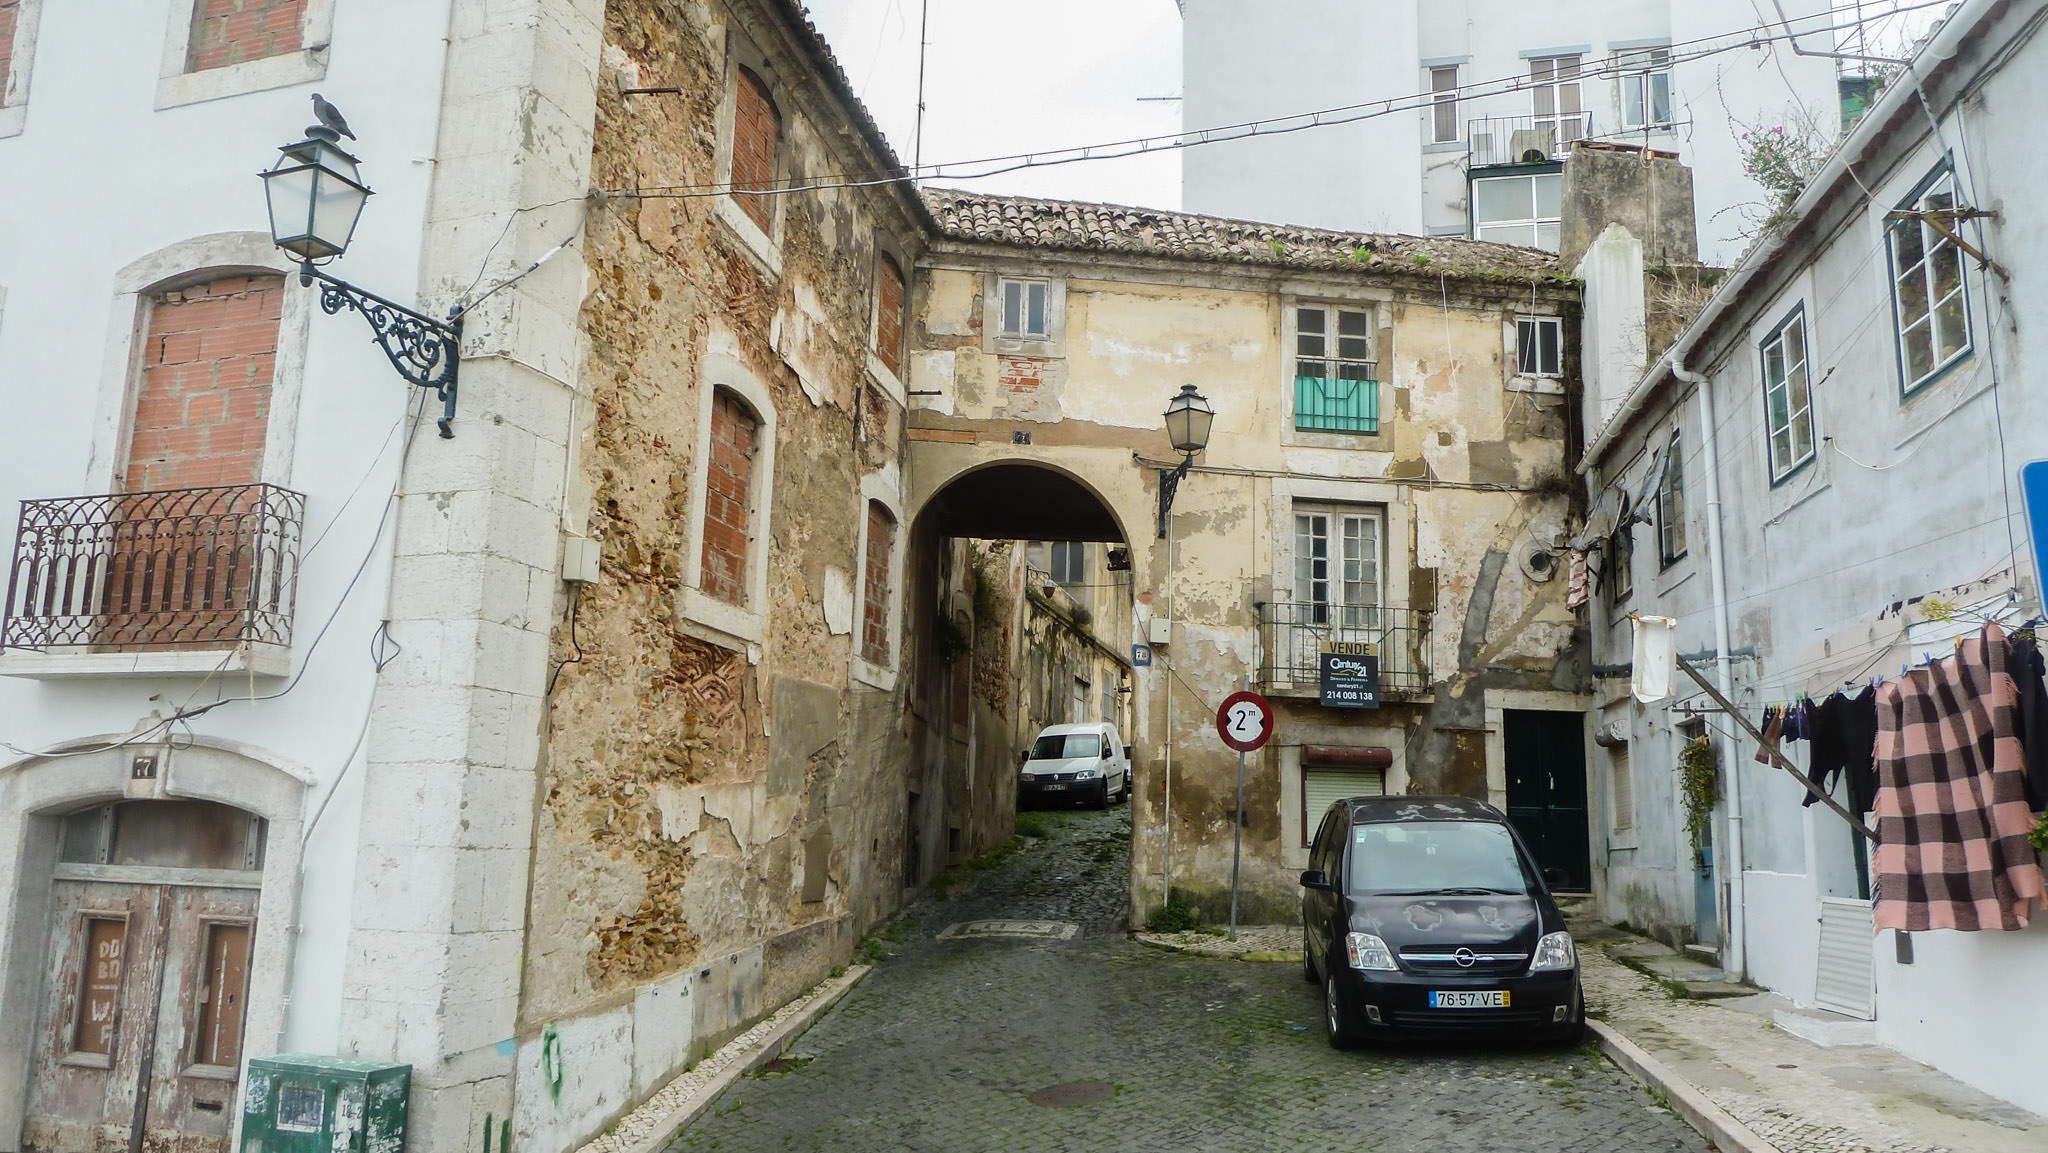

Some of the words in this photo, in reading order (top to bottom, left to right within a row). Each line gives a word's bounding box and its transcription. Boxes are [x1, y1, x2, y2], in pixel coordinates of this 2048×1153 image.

[1329, 641, 1371, 656] VENDE
[1329, 657, 1361, 670] Century
[1357, 666, 1368, 677] 21
[1326, 690, 1341, 699] 214
[1342, 691, 1357, 700] 008
[1359, 692, 1373, 701] 138
